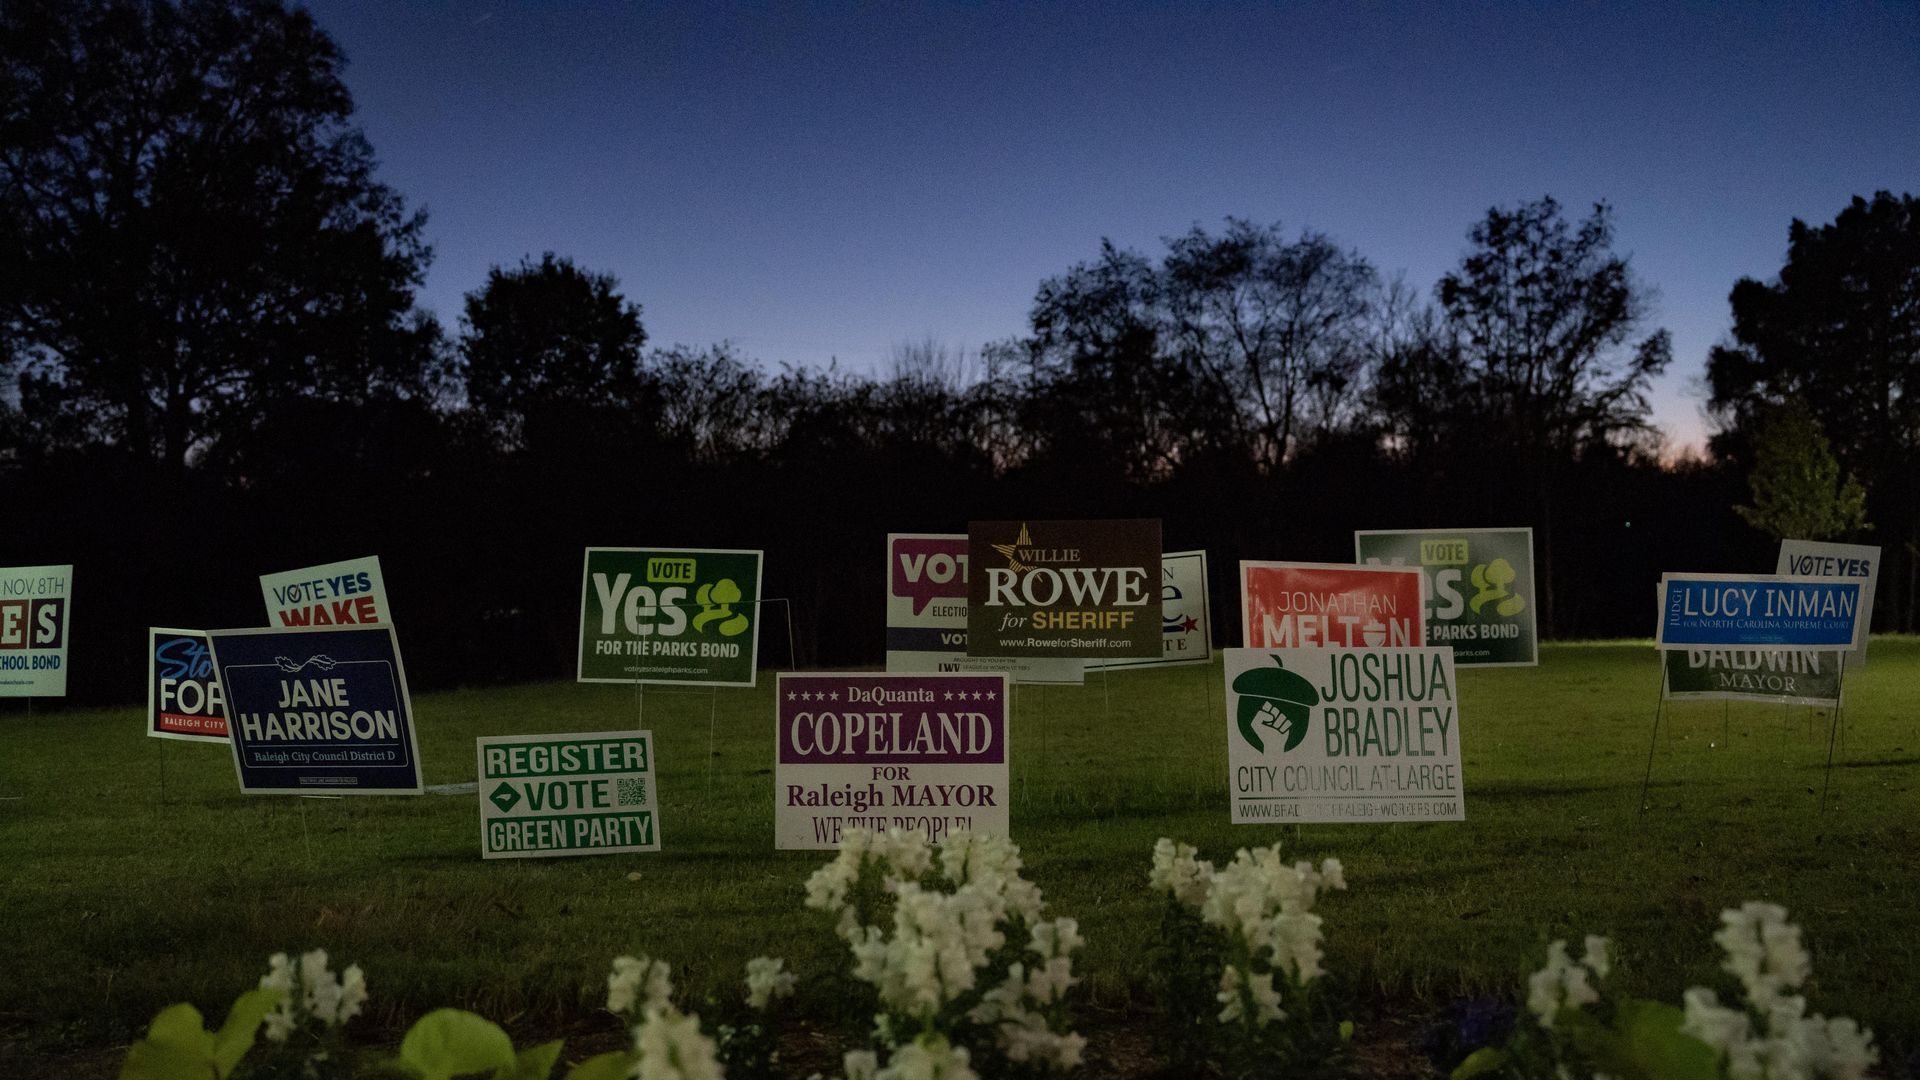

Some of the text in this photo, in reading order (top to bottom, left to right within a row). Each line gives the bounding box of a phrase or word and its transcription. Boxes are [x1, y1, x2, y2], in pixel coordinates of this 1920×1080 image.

[1018, 549, 1081, 562] WILLIE
[1424, 543, 1465, 561] VOTE
[652, 562, 692, 579] VOTE
[1790, 554, 1870, 577] VOTE YES
[3, 577, 65, 595] NOV. 8TH
[273, 572, 372, 606] VOTE YES
[984, 566, 1150, 607] ROWE
[279, 595, 379, 627] WAKE
[592, 572, 688, 637] Yes
[1277, 591, 1397, 615] JONATHAN
[1670, 588, 1683, 627] JUDGE
[1684, 587, 1855, 618] LUCY INMAN
[998, 610, 1135, 632] for SHERIFF
[1433, 625, 1478, 641] PARKS
[1481, 623, 1520, 639] BOND
[1683, 620, 1697, 628] FOR
[1700, 618, 1733, 629] NORTH
[1736, 619, 1781, 629] CAROLINA
[1783, 620, 1822, 630] SUPREME
[595, 640, 740, 659] FOR THE PARKS BOND
[1000, 637, 1132, 649] www.RoweforSheriff.com
[0, 655, 61, 670] HOOL BOND
[1688, 650, 1821, 676] BALDWIN
[1321, 652, 1452, 702] JOSHUA
[1719, 672, 1798, 693] MAYOR
[278, 678, 350, 709] JANE
[847, 686, 935, 706] DaQuanta
[164, 717, 225, 729] RALEIGH CITY
[240, 709, 399, 742] HARRISON
[791, 711, 993, 756] COPELAND
[1324, 706, 1453, 757] BRADLEY
[255, 750, 396, 765] Raleigh City Council District D
[486, 742, 645, 776] REGISTER
[872, 766, 911, 781] FOR
[1238, 764, 1456, 793] CITY COUNCIL AT-LARGE
[524, 779, 611, 811] VOTE
[787, 783, 997, 813] Raleigh MAYOR
[490, 815, 650, 851] GREEN PARTY
[812, 816, 843, 844] WE
